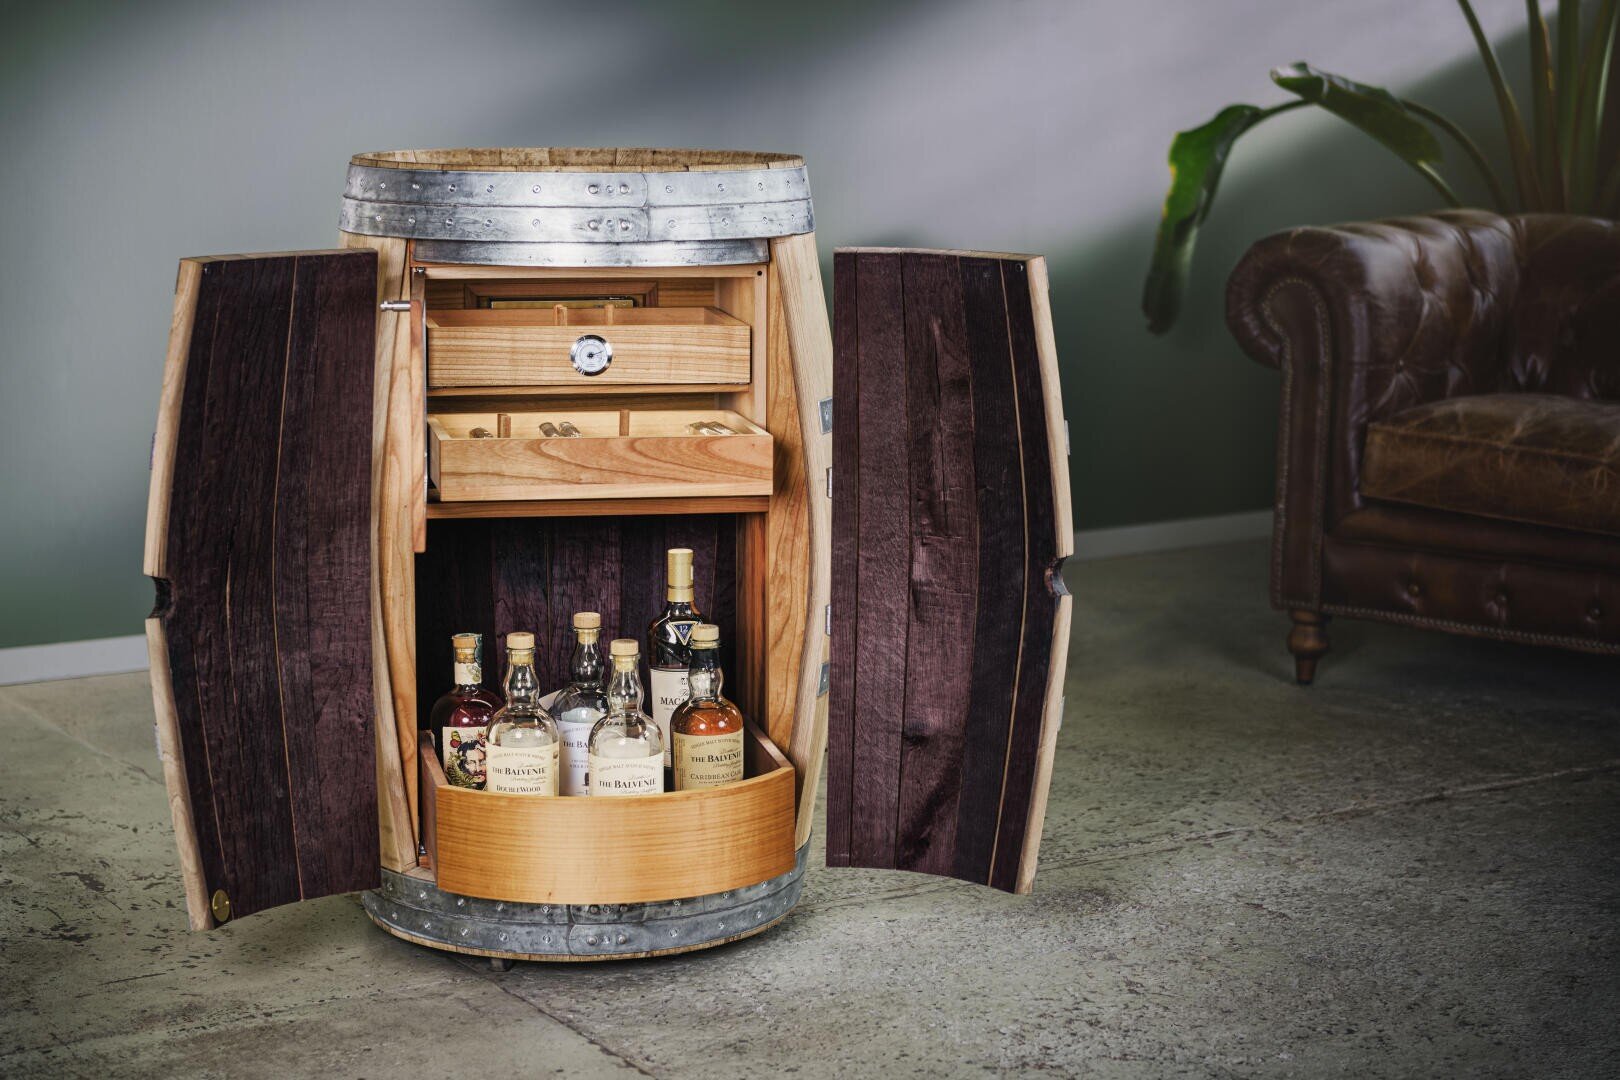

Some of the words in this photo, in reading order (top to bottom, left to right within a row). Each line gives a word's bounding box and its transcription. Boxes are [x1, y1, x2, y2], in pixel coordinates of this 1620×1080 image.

[679, 625, 688, 633] 12
[707, 750, 742, 763] BALVENIE
[492, 766, 505, 775] THE
[505, 767, 546, 776] BALVENIE
[599, 780, 611, 788] THE
[614, 778, 656, 788] BALVENIE
